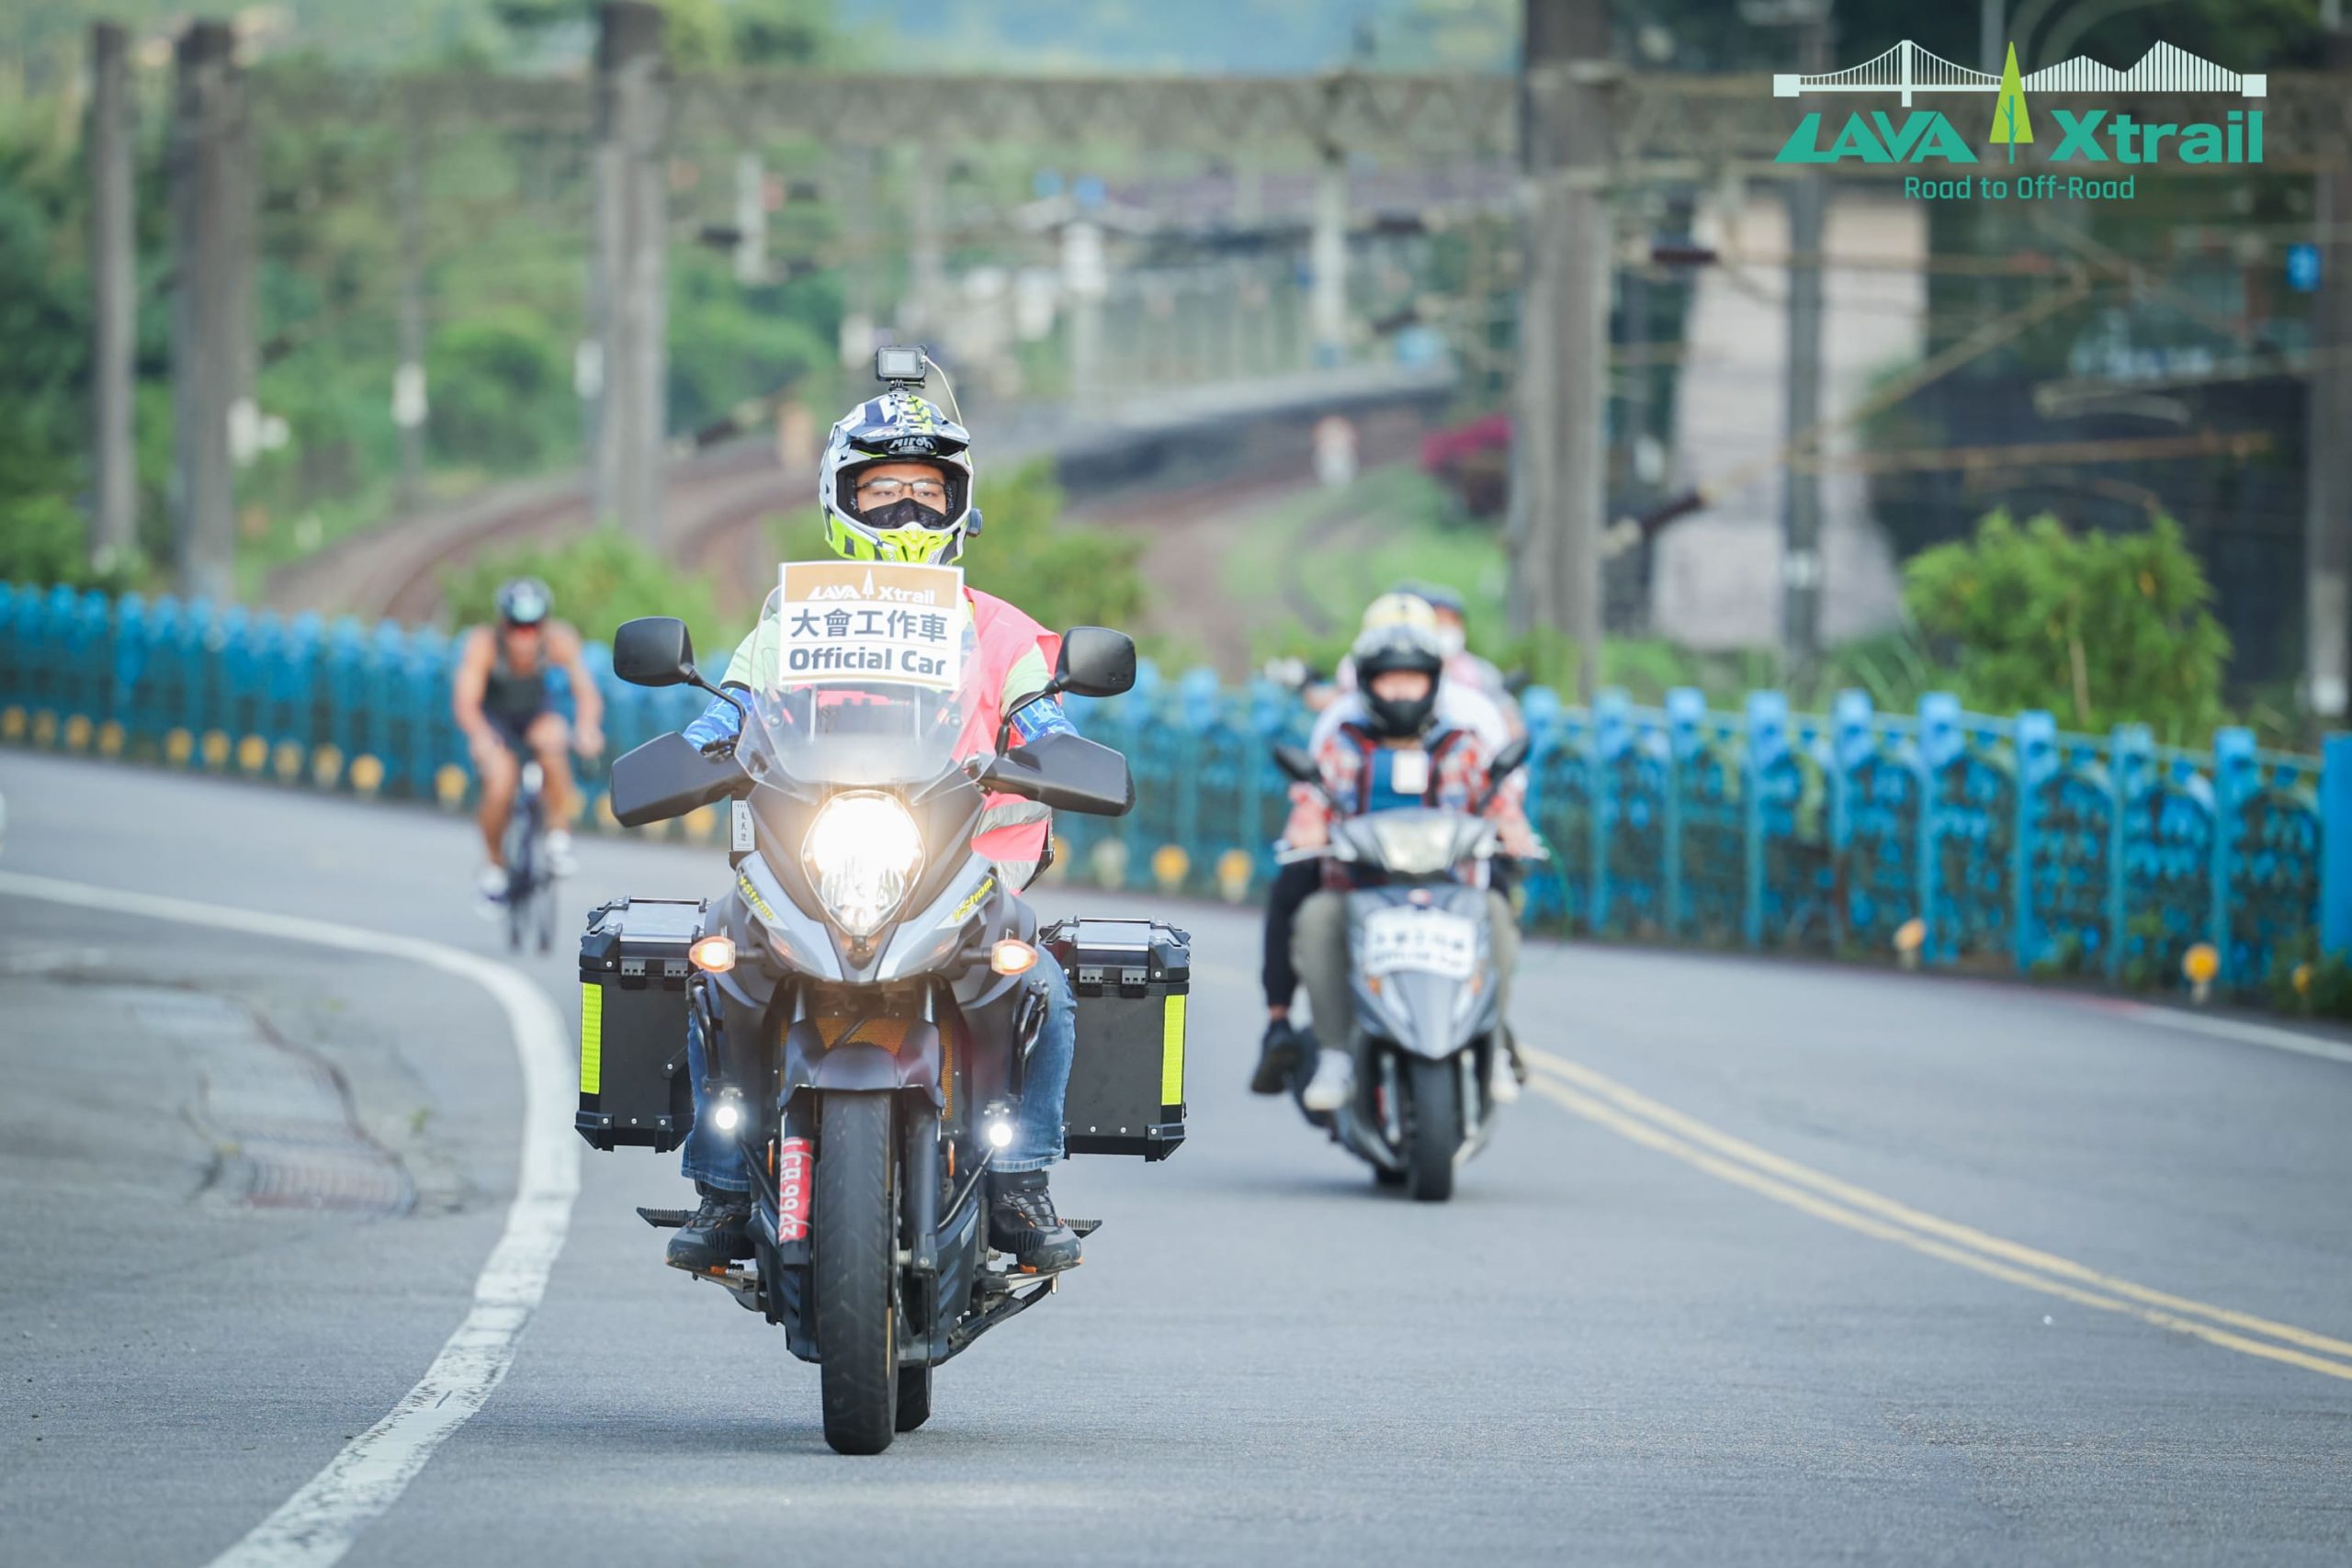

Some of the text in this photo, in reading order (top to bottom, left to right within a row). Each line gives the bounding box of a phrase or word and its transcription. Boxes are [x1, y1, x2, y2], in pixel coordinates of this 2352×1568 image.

[807, 584, 935, 604] LAVA Xtrail
[790, 608, 947, 642] 大會工作車
[789, 647, 946, 676] Official Car
